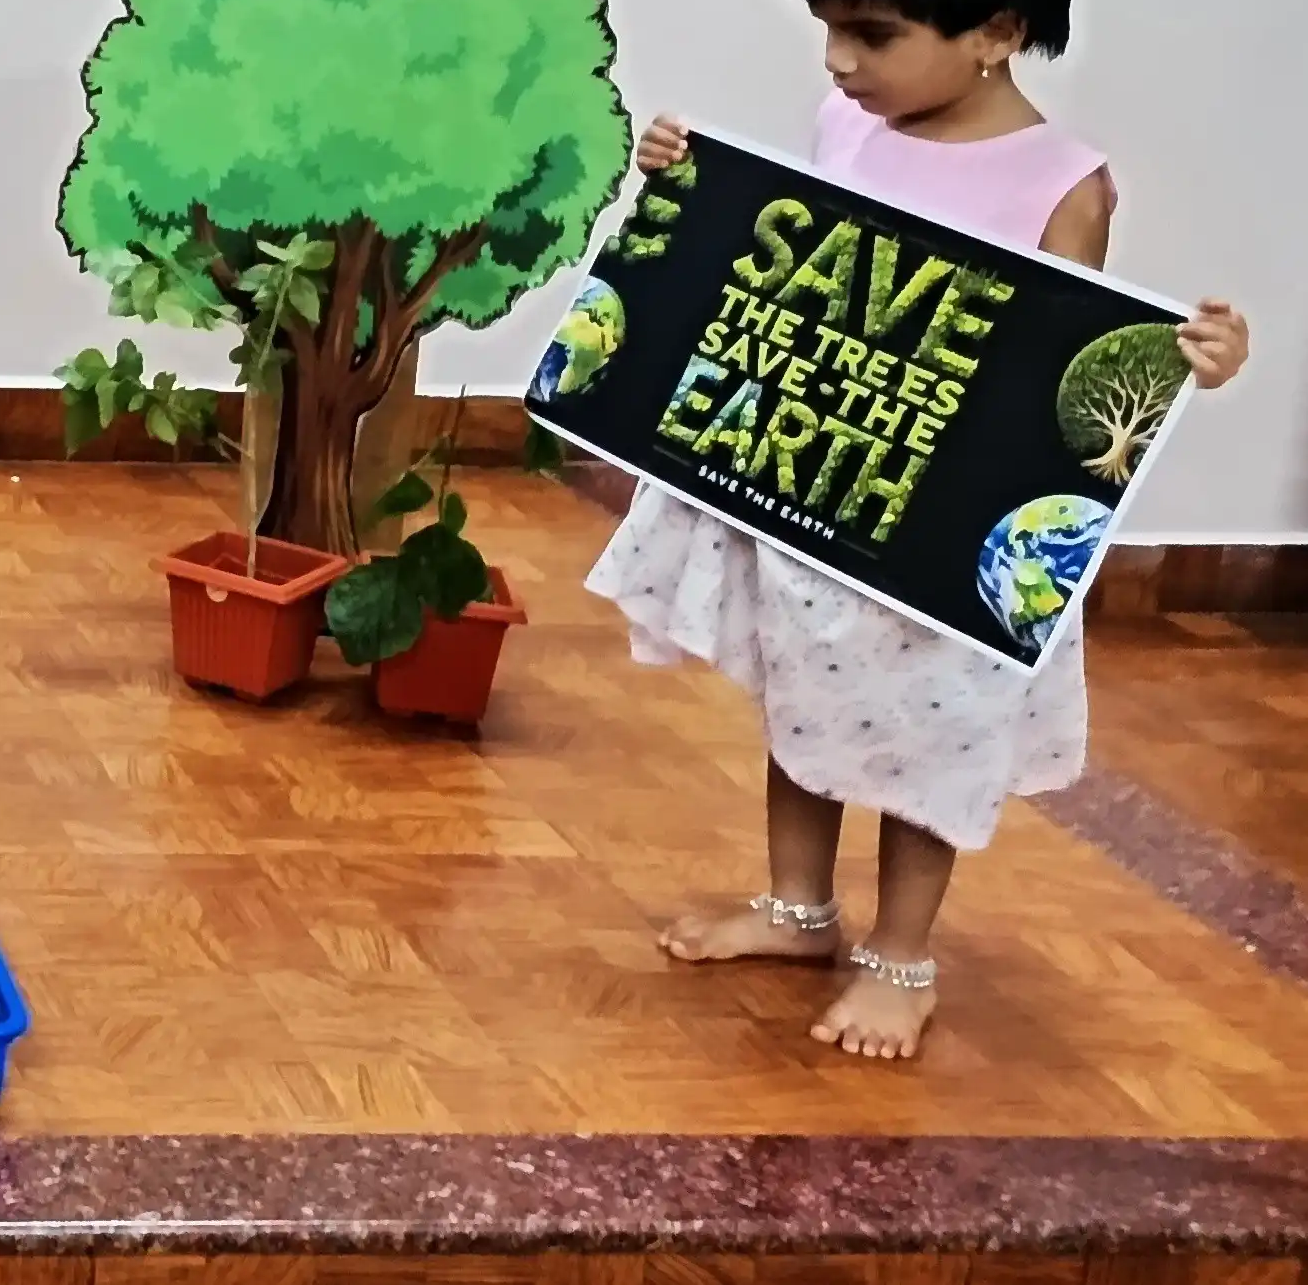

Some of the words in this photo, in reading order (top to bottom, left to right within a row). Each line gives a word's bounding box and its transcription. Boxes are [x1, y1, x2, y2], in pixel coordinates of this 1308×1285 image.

[712, 283, 805, 349] THE
[812, 325, 966, 416] TREES
[732, 197, 1016, 378] SAVE
[656, 353, 931, 543] EARTH
[698, 321, 817, 397] SAVE
[836, 378, 946, 455] THE
[698, 464, 739, 493] SAVE
[744, 486, 776, 511] THE
[779, 505, 835, 540] EARTH
